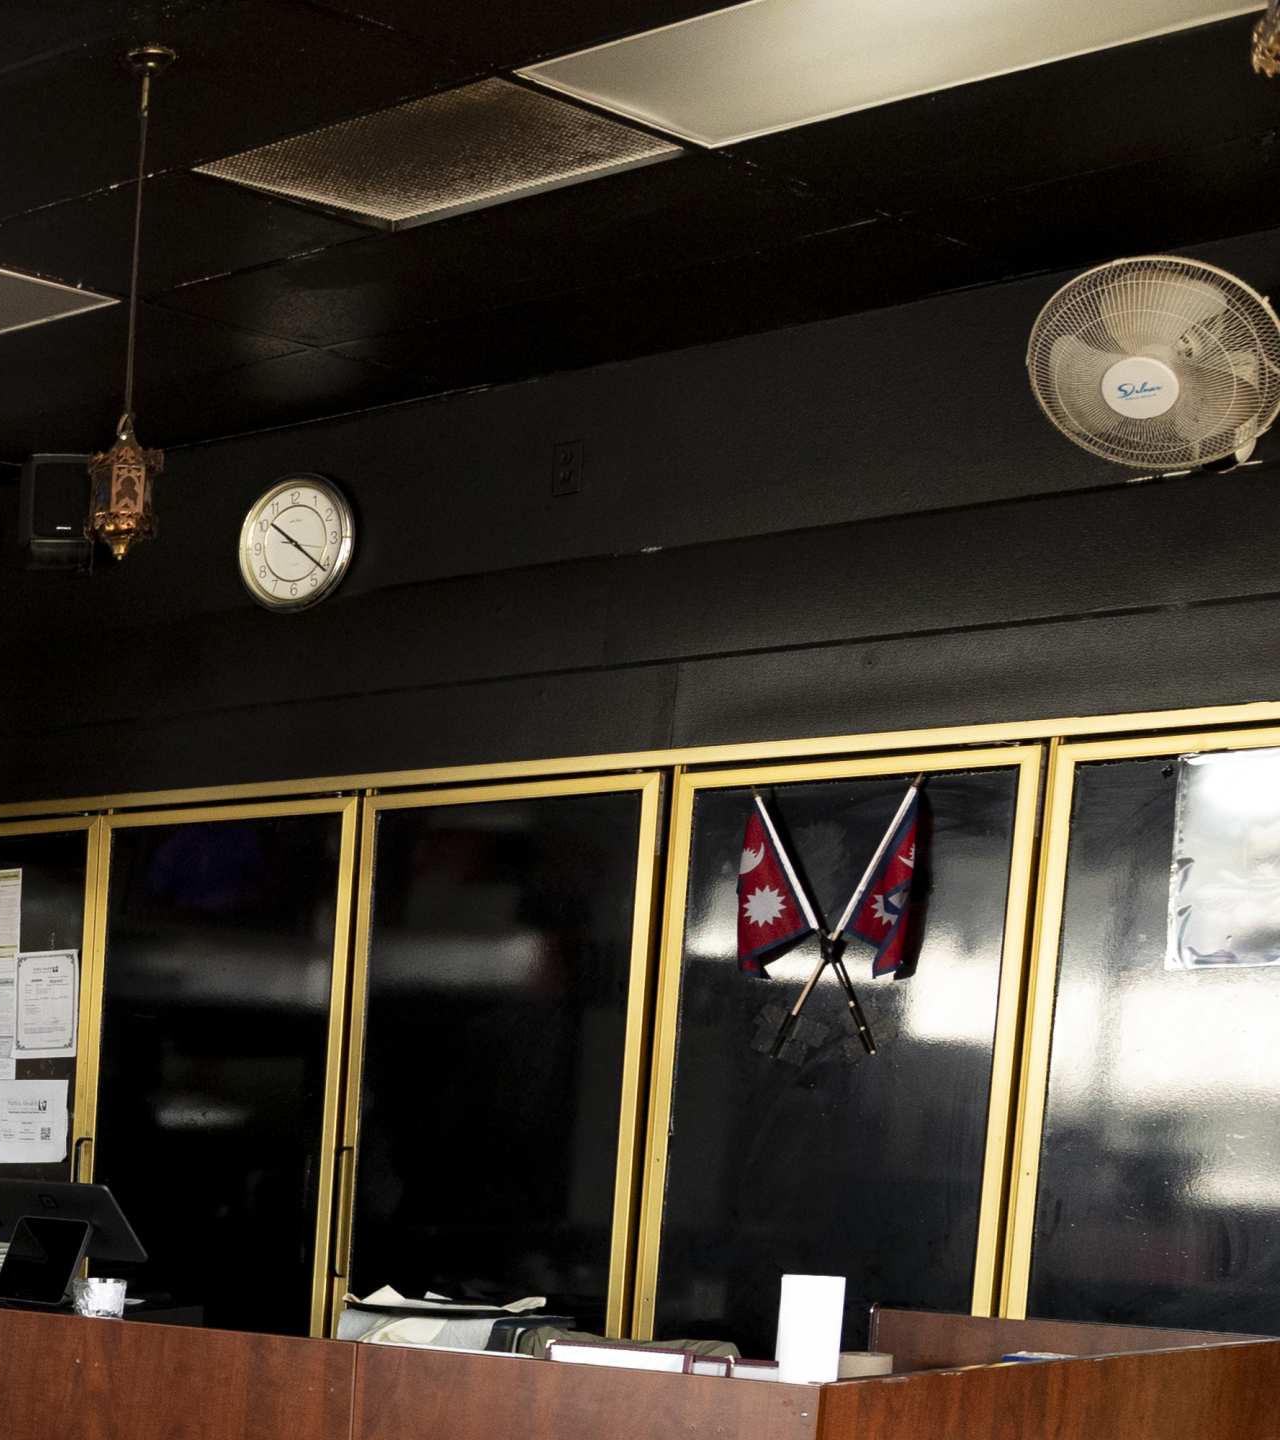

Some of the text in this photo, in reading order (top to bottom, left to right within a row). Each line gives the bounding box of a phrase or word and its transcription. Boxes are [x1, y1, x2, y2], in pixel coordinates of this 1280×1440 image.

[290, 491, 301, 505] 12
[313, 496, 318, 506] 1
[271, 502, 280, 515] 11
[326, 508, 333, 522] 2
[260, 520, 270, 532] 10
[330, 531, 338, 545] 3
[254, 543, 262, 556] 9
[259, 565, 267, 579] 8
[272, 580, 278, 593] 7
[311, 573, 318, 588] 5
[290, 583, 298, 597] 6
